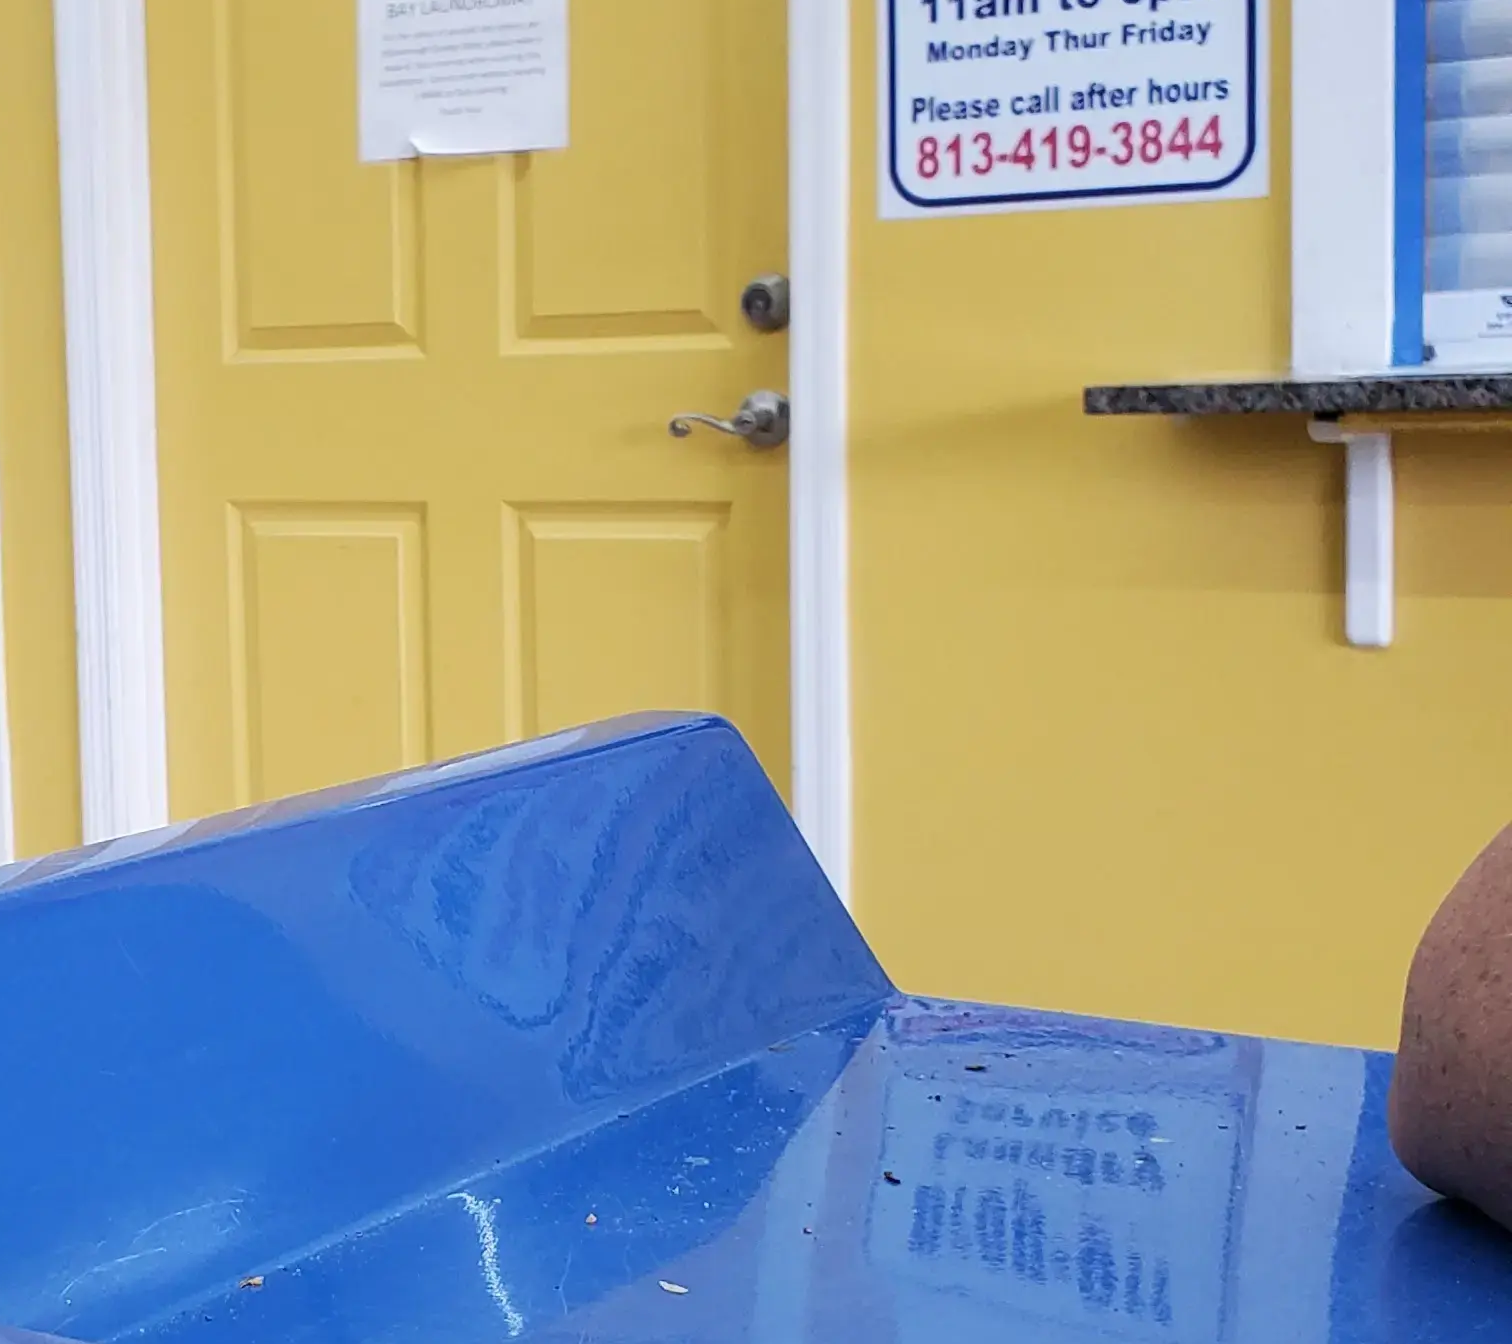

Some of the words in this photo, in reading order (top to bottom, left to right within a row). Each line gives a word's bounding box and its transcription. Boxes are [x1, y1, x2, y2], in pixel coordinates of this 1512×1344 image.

[926, 35, 1035, 64] Monday
[1045, 28, 1111, 53] Thur
[1121, 20, 1211, 46] Friday
[911, 96, 1001, 123] Please
[1011, 85, 1060, 116] call
[1071, 82, 1138, 112] after
[1148, 77, 1230, 107] hours
[917, 114, 1223, 180] 813-419-3844
